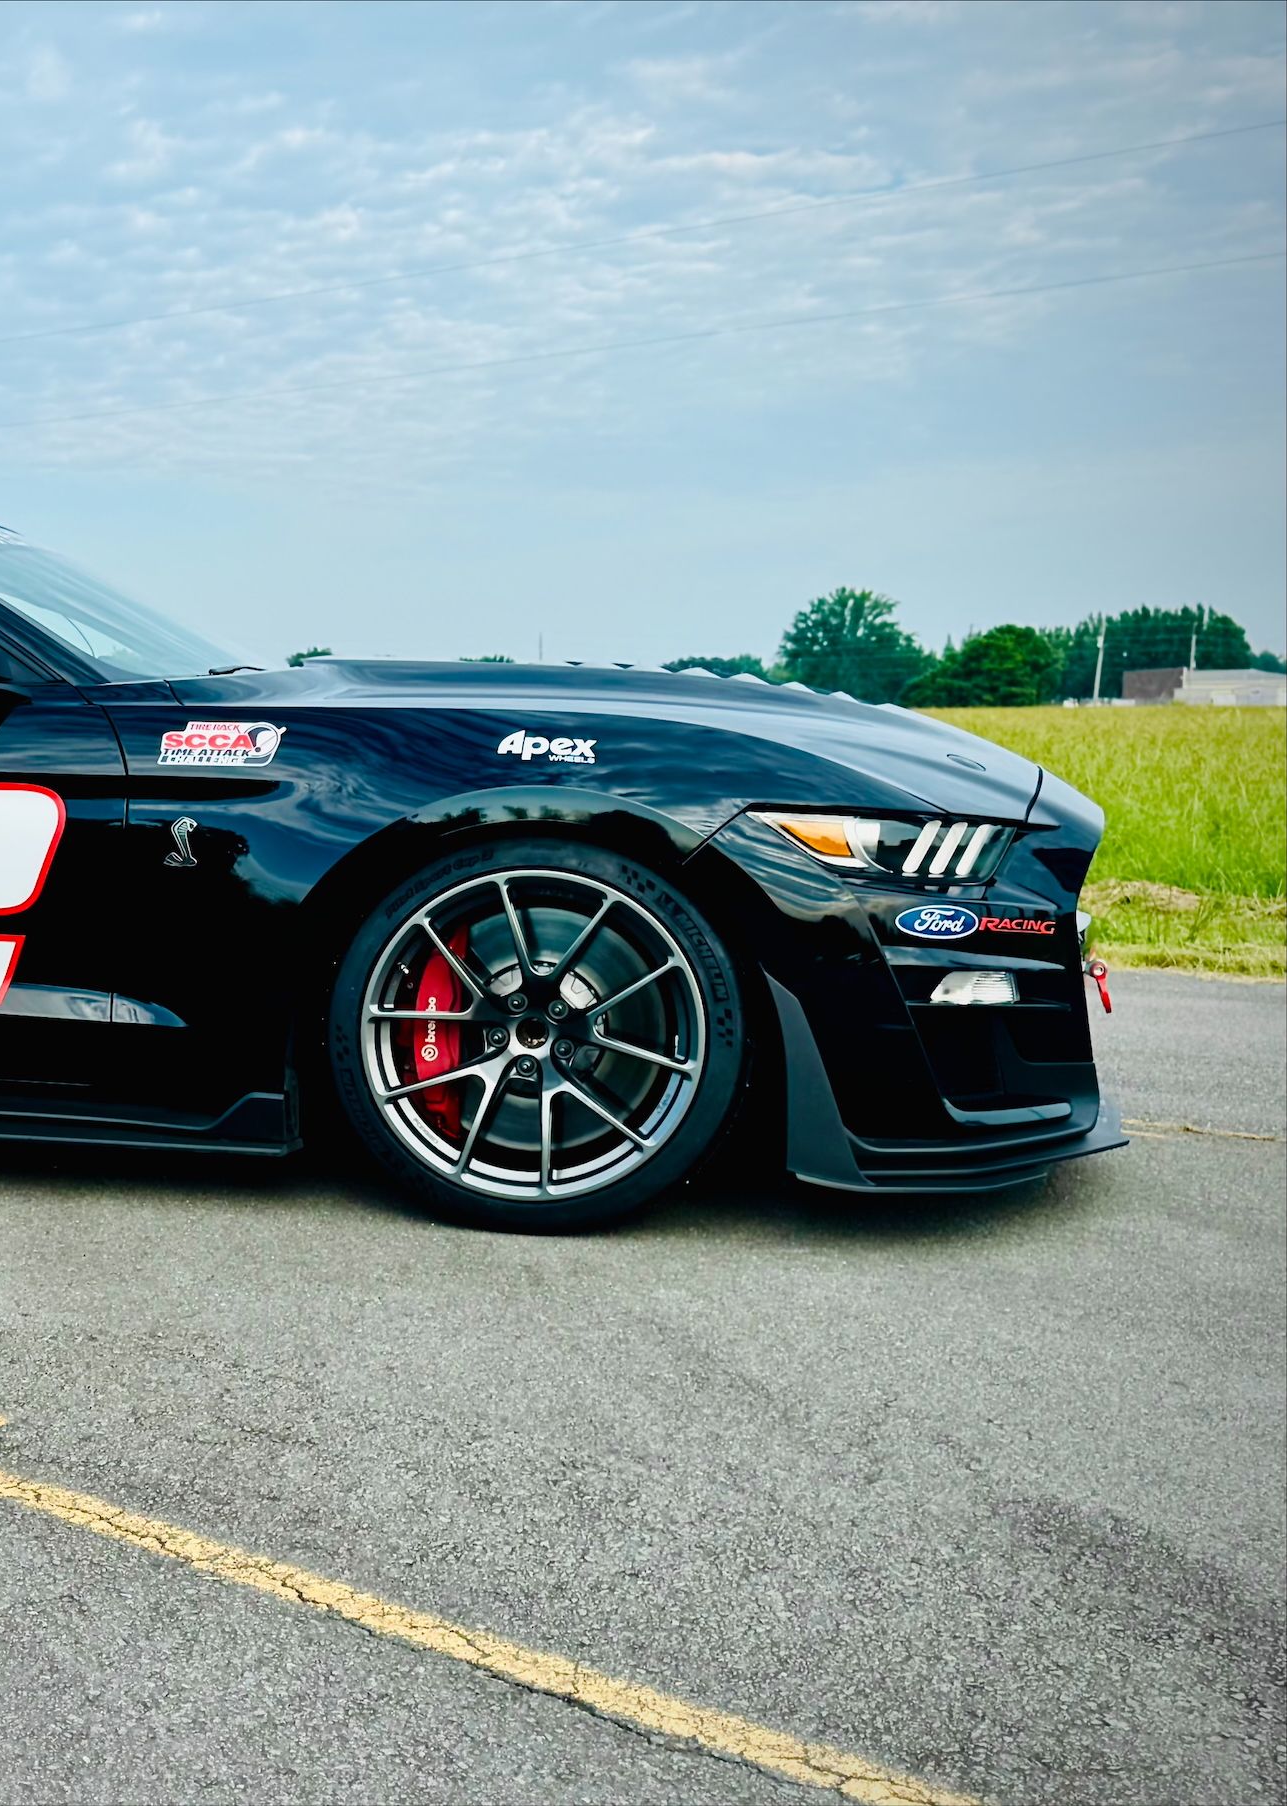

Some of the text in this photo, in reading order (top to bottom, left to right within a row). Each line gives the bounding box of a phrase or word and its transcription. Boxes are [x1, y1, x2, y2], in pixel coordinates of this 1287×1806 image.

[189, 723, 241, 733] TIRE RACK
[164, 734, 253, 749] SCCA
[497, 729, 597, 761] Apex
[163, 748, 252, 757] TIME ATTACK
[548, 754, 596, 764] WHEELS
[978, 917, 1056, 934] RACING
[424, 996, 437, 1043] brebo
